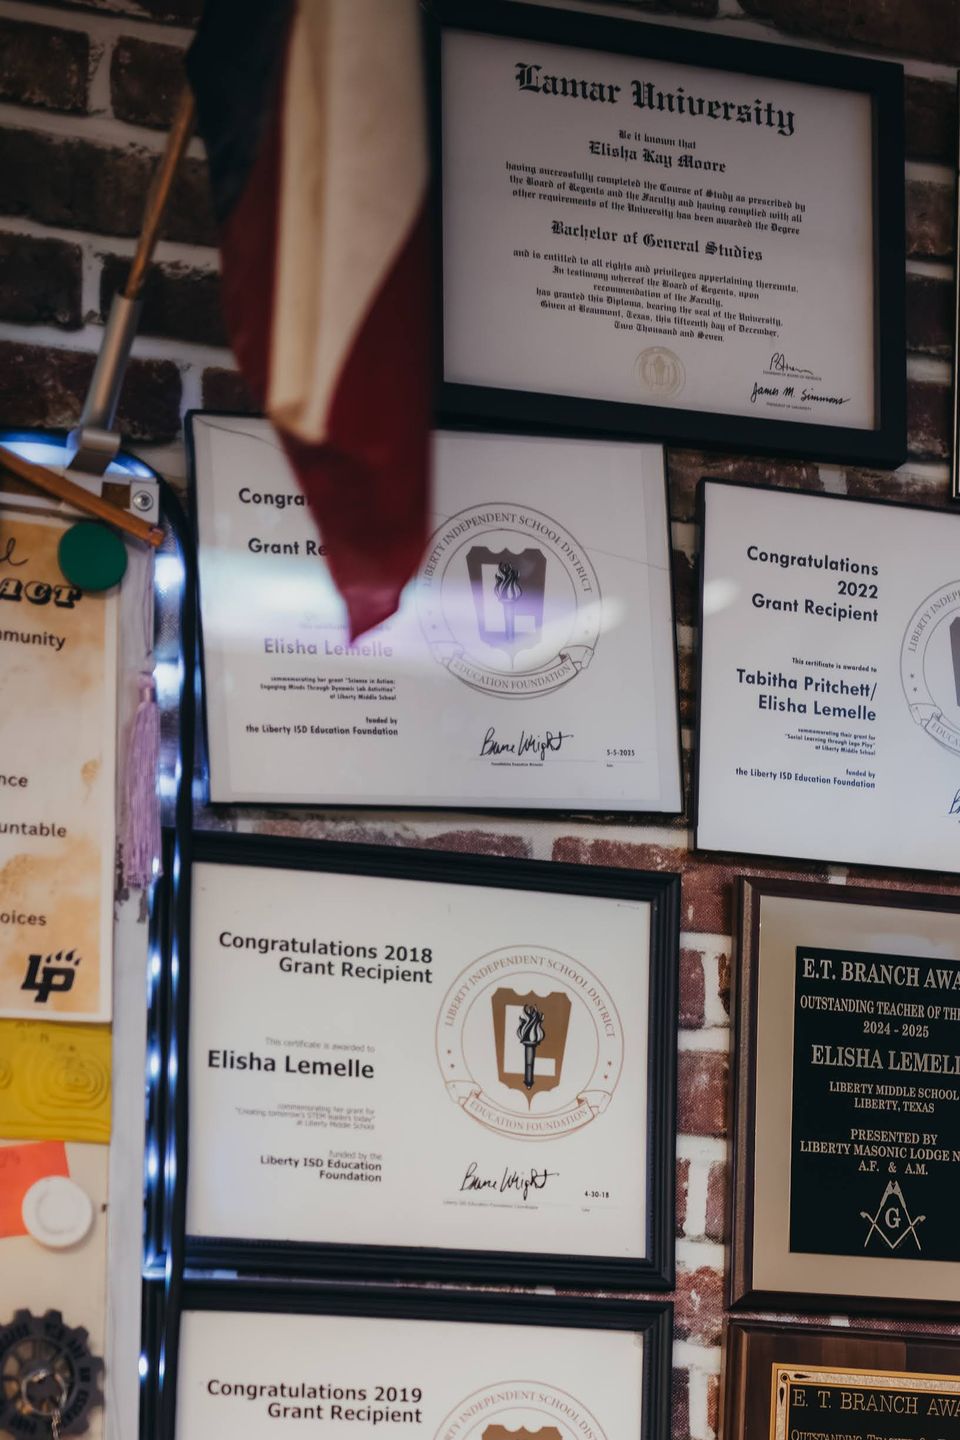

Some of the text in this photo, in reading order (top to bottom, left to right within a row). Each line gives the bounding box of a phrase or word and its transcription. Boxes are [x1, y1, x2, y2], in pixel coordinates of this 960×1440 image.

[515, 62, 795, 136] Lamar University
[589, 140, 726, 173] Elisha Kay Moore
[551, 220, 762, 261] Bachelor of General Studies
[747, 546, 878, 576] Congratulations
[838, 580, 878, 599] 2022
[752, 593, 878, 622] Grant Recipient
[736, 668, 797, 689] Tabitha
[759, 694, 876, 721] Elisha Lemelle
[246, 724, 398, 735] the Liberty ISD Education Foundation
[736, 767, 875, 788] the Liberty ISD Education Foundation
[219, 932, 432, 964] Congratulations 2018
[279, 957, 432, 984] Grant Recipient
[802, 958, 836, 980] E.T.
[841, 961, 920, 987] BRANCH
[800, 995, 874, 1014] OUTSTANDING
[876, 1001, 925, 1018] TEACHER
[927, 1005, 941, 1019] OF
[863, 1020, 890, 1035] 2024
[902, 1024, 929, 1038] 2025
[208, 1050, 374, 1078] Elisha Lemelle
[811, 1044, 884, 1069] ELISHA
[830, 1081, 959, 1101] LIBERTY MIDDLE SCHOOL
[851, 1129, 938, 1145] PRESENTED BY
[800, 1140, 851, 1155] LIBERTY
[853, 1144, 907, 1159] MASONIC
[910, 1148, 950, 1161] LODGE
[207, 1379, 422, 1403] Congratulations 2019
[840, 1392, 918, 1414] BRANCH
[268, 1402, 422, 1425] Grant Recipient
